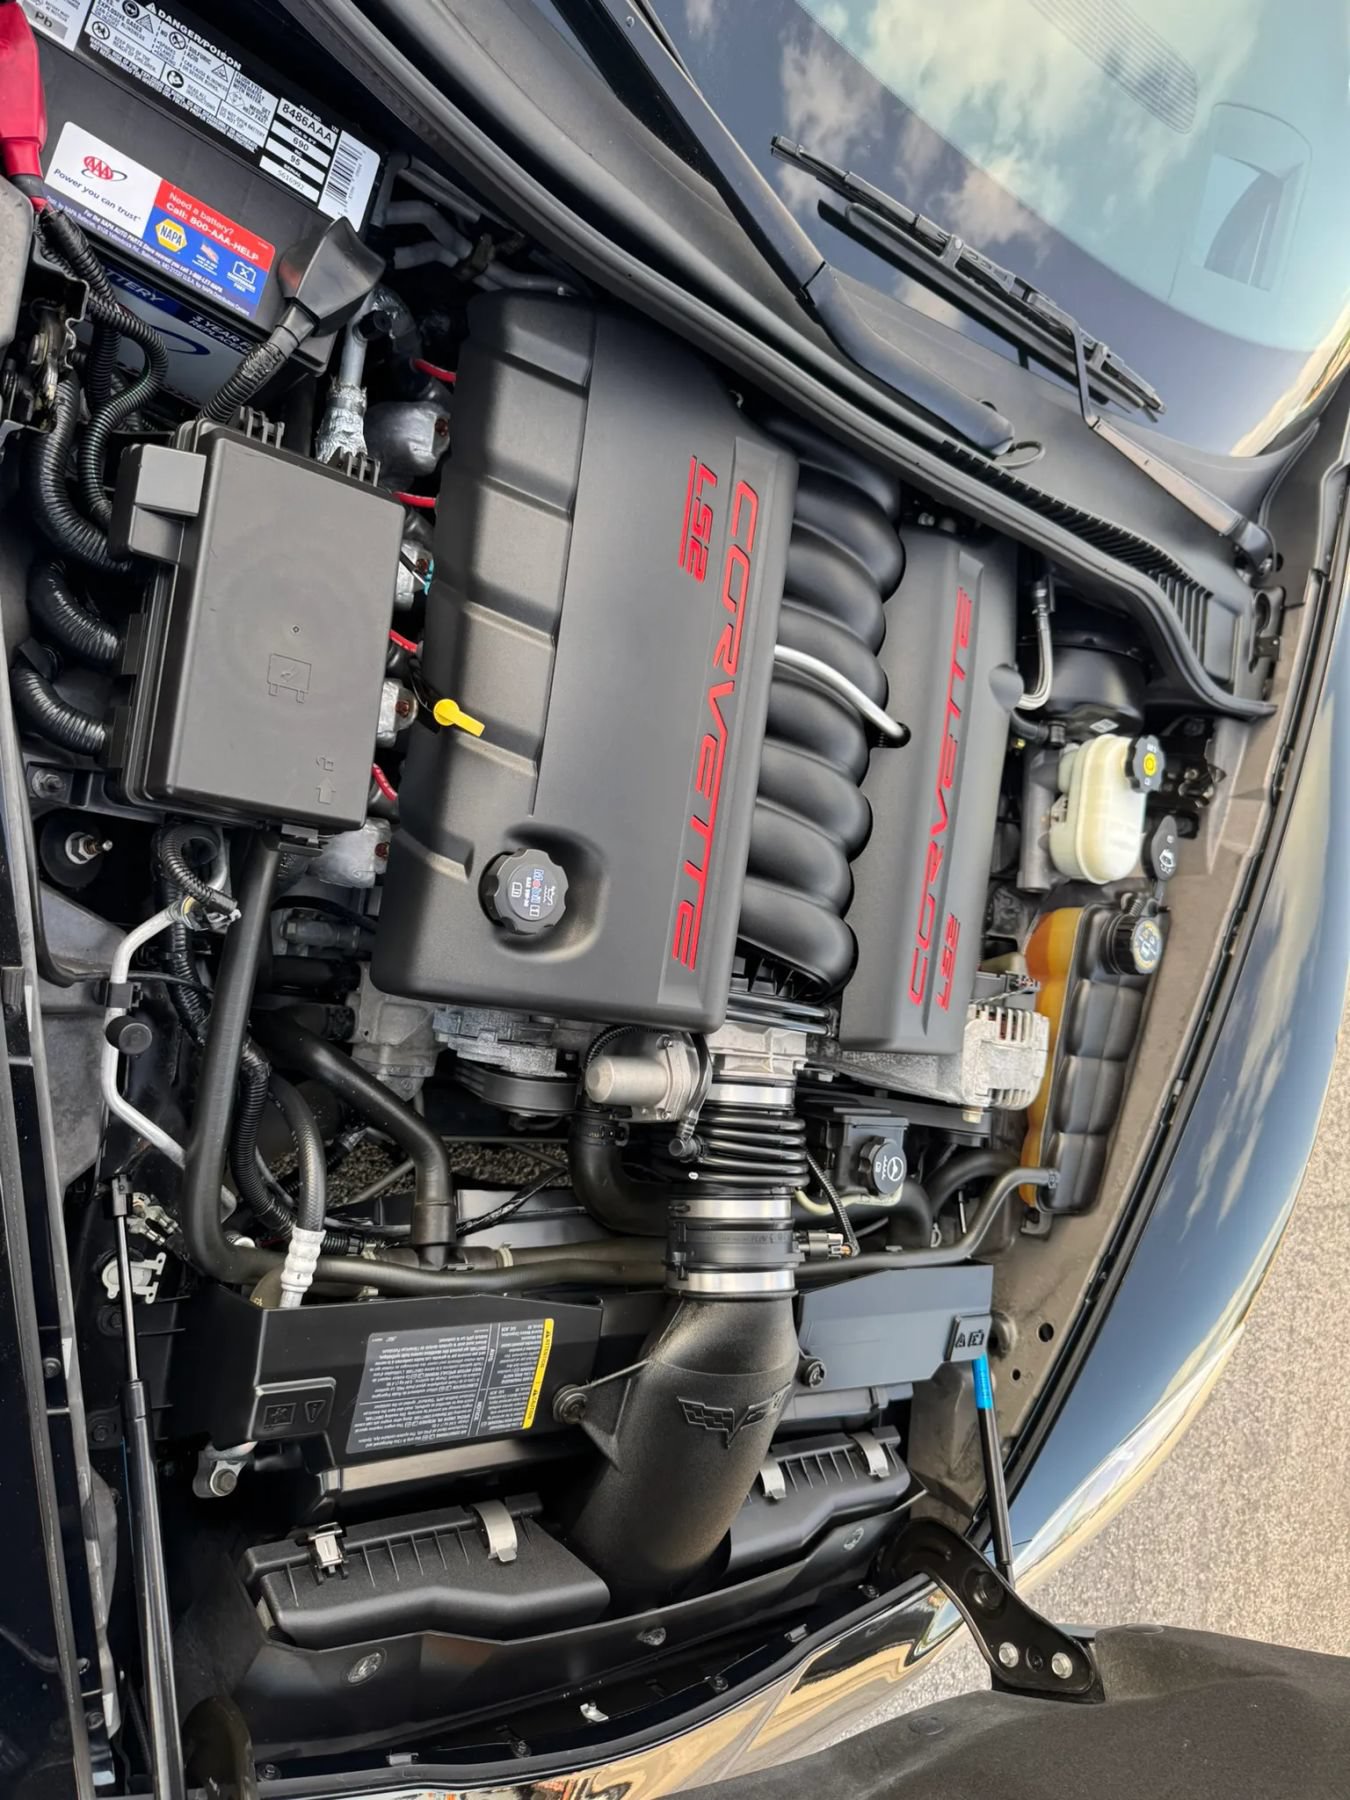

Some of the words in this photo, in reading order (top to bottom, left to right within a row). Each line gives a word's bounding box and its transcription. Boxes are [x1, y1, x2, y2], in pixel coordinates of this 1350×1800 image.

[34, 9, 53, 28] Pb
[157, 9, 242, 70] DANGER/POISON
[186, 51, 199, 63] ACID
[281, 102, 333, 143] 8486AAA
[289, 153, 301, 167] 95
[292, 135, 309, 152] 690
[52, 166, 82, 189] Power
[81, 185, 99, 201] you
[100, 195, 116, 209] can
[82, 151, 115, 184] AAA
[159, 223, 183, 247] NAPA
[165, 200, 188, 220] Call:
[189, 215, 259, 262] 800-AAA-HELP
[168, 191, 192, 211] Need
[192, 207, 199, 216] a
[198, 209, 234, 238] battery?
[188, 316, 249, 357] REPLACEM
[204, 319, 240, 345] YEAR
[684, 461, 718, 584] LS2
[672, 480, 759, 972] CORVETTE
[908, 587, 972, 1006] CORVETTE
